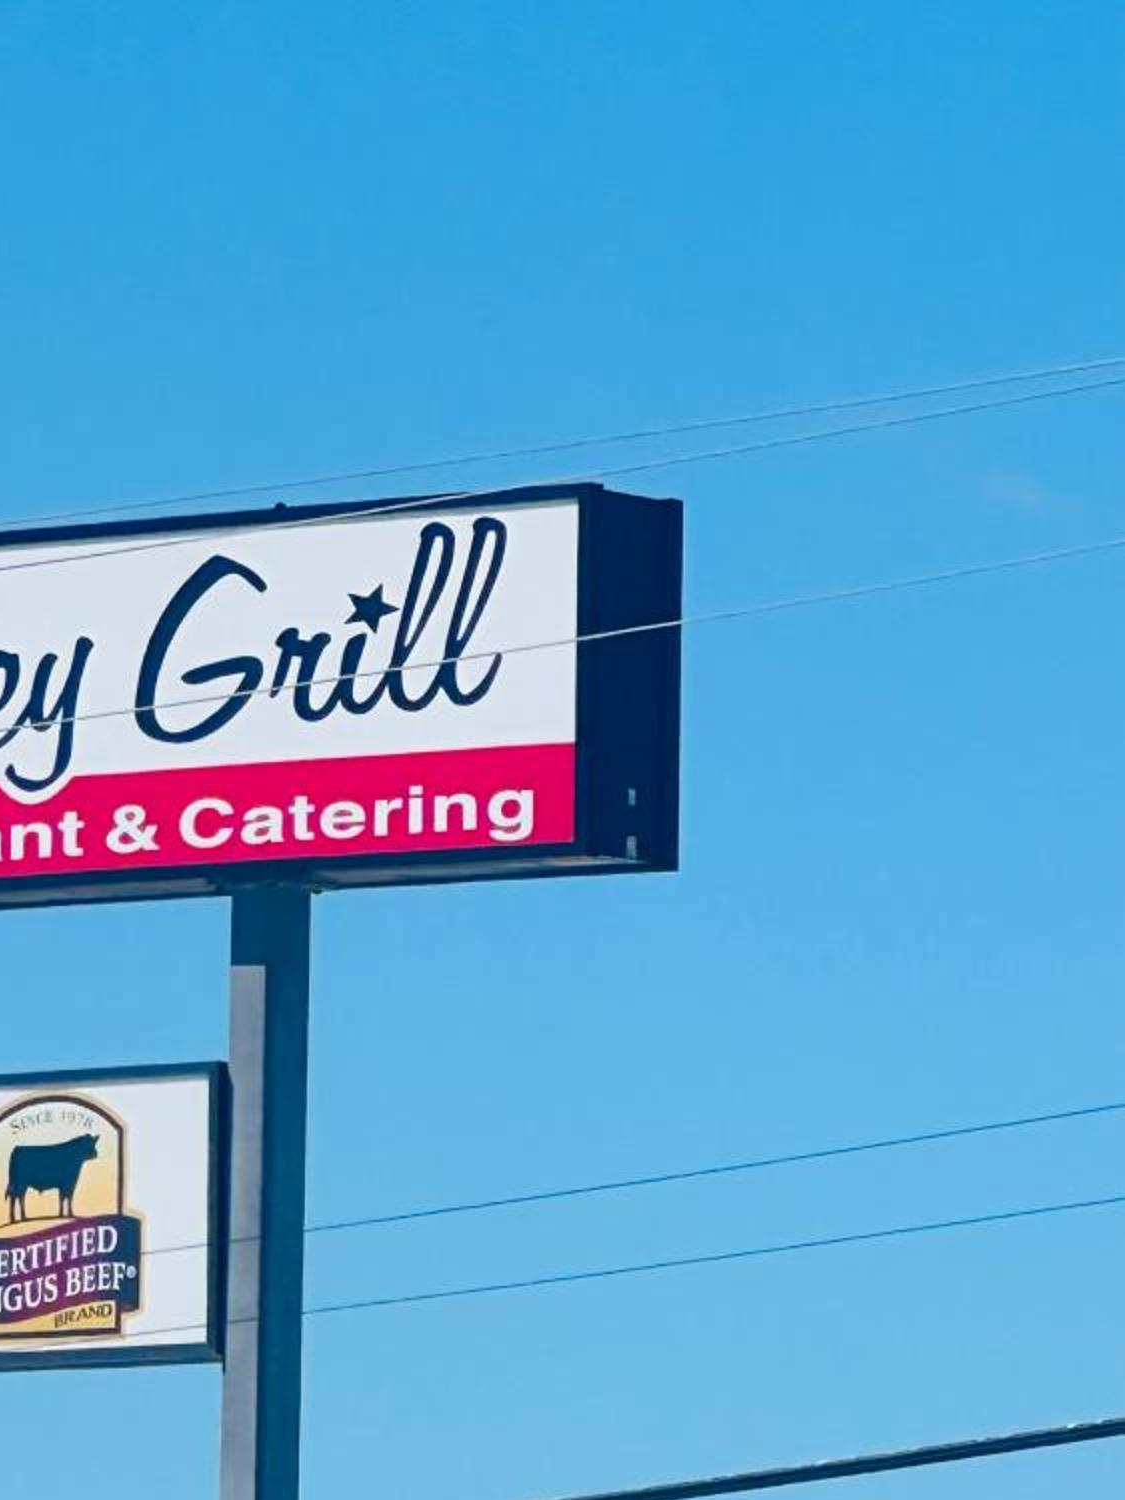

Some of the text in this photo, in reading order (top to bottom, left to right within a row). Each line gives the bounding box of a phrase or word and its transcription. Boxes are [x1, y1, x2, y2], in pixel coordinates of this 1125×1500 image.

[134, 518, 506, 744] Grill
[105, 804, 160, 854] &
[179, 785, 534, 842] Catering
[54, 1303, 113, 1328] BRAND
